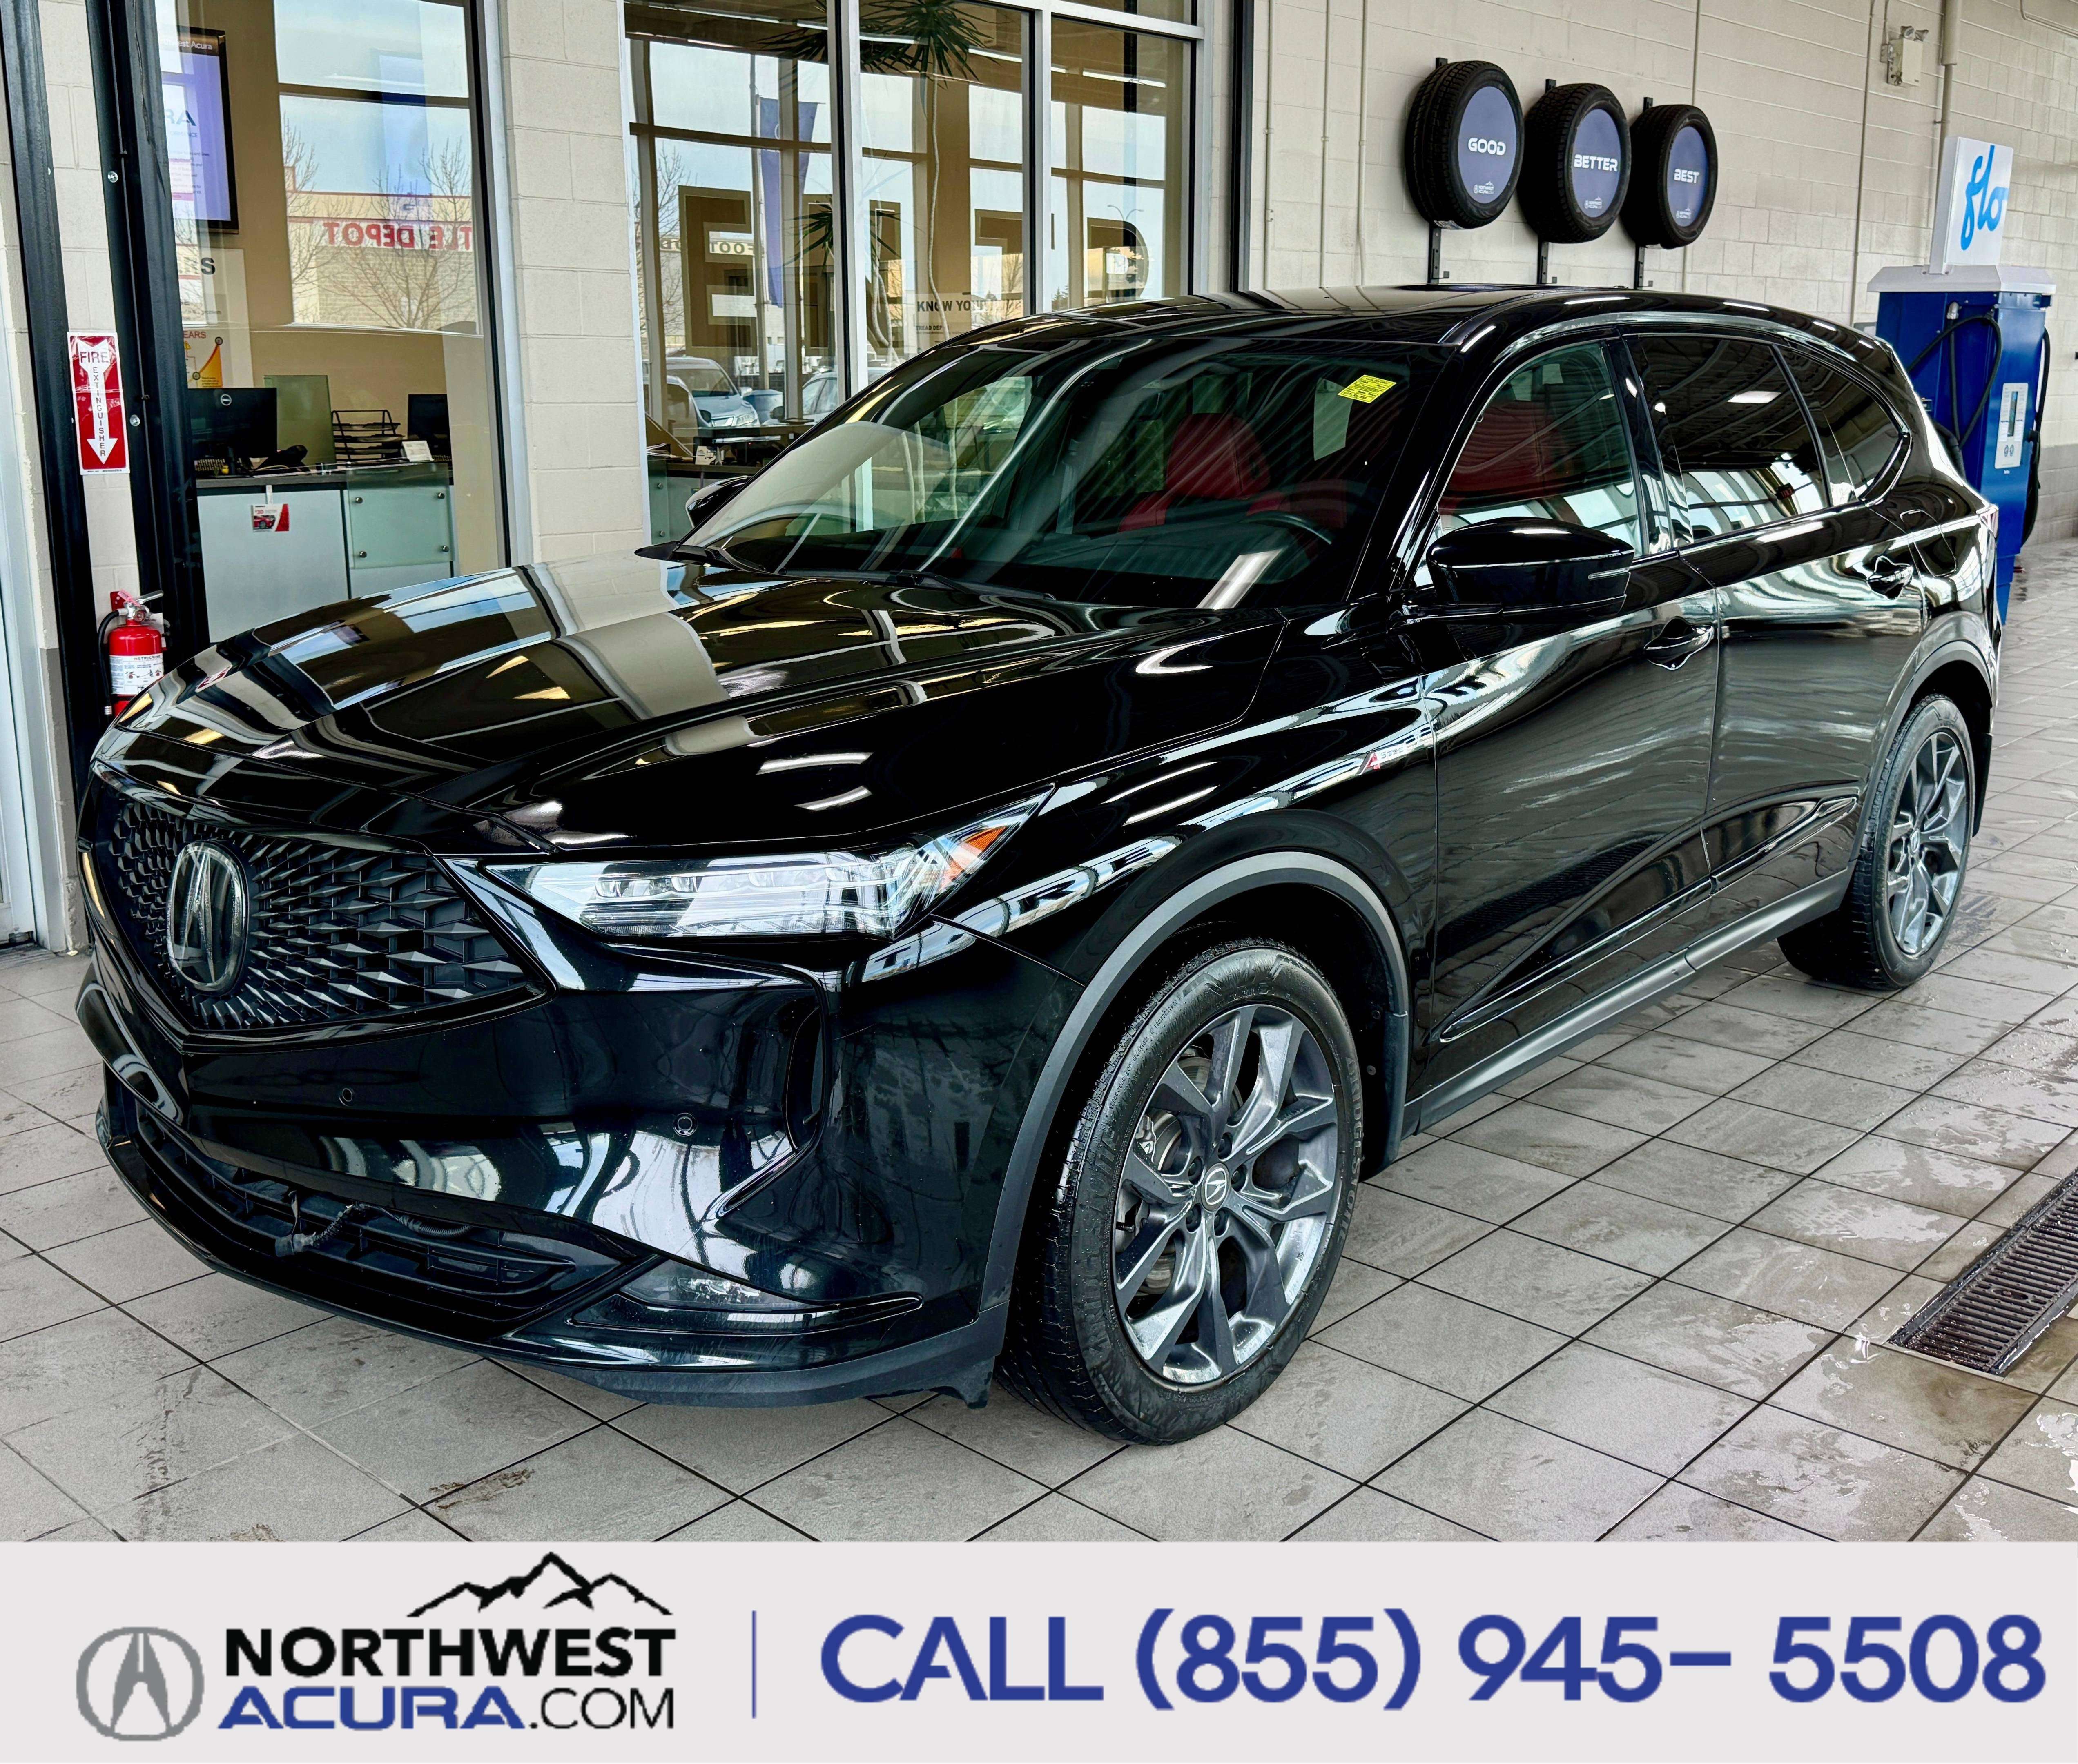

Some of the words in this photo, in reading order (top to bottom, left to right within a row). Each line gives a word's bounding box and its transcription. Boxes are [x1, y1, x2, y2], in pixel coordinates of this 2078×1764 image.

[191, 41, 212, 50] Acura
[1468, 138, 1506, 156] GOOD
[1574, 154, 1618, 172] BETTER
[1674, 168, 1699, 184] BEST
[1960, 145, 2009, 250] flo
[917, 300, 952, 312] KNOW
[80, 351, 109, 363] FIRE
[93, 367, 105, 457] EXTINGUISHER
